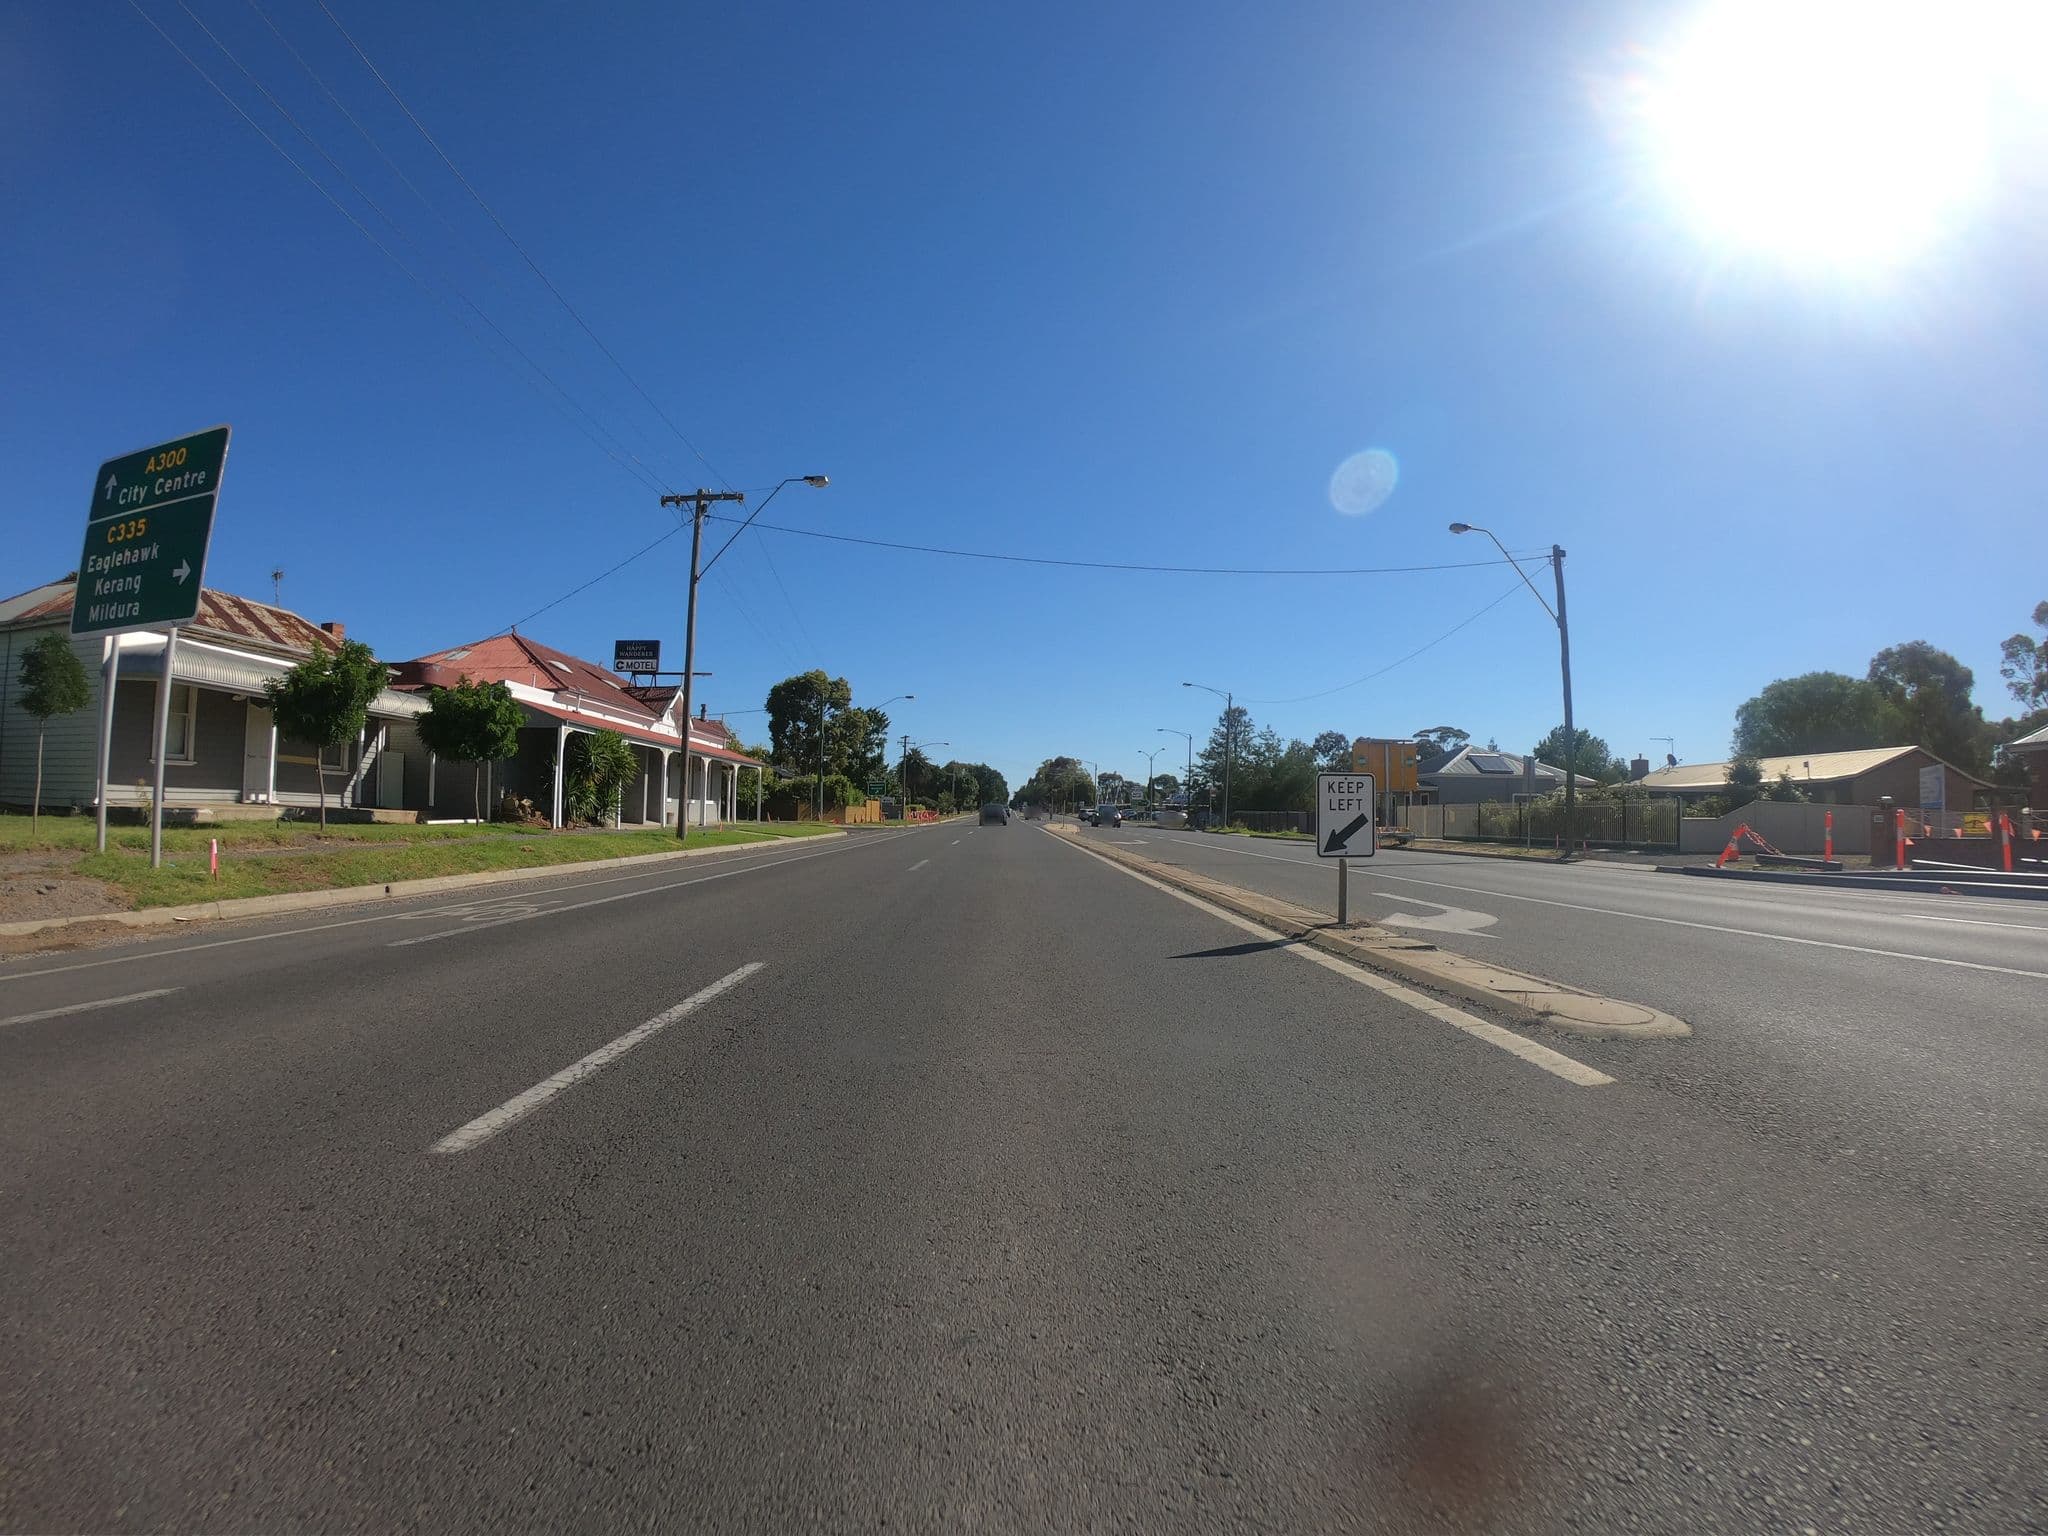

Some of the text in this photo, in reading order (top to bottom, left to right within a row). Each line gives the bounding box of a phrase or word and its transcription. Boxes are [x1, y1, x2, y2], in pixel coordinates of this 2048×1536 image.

[145, 447, 187, 475] A300
[119, 470, 206, 505] City Centre
[107, 518, 147, 544] C335
[87, 542, 160, 574] Eaglehawk
[95, 573, 142, 597] Kerang
[88, 601, 140, 623] Mildura
[625, 661, 656, 670] MOTEL
[1327, 781, 1364, 794] KEEP
[1329, 798, 1363, 811] LEFT
